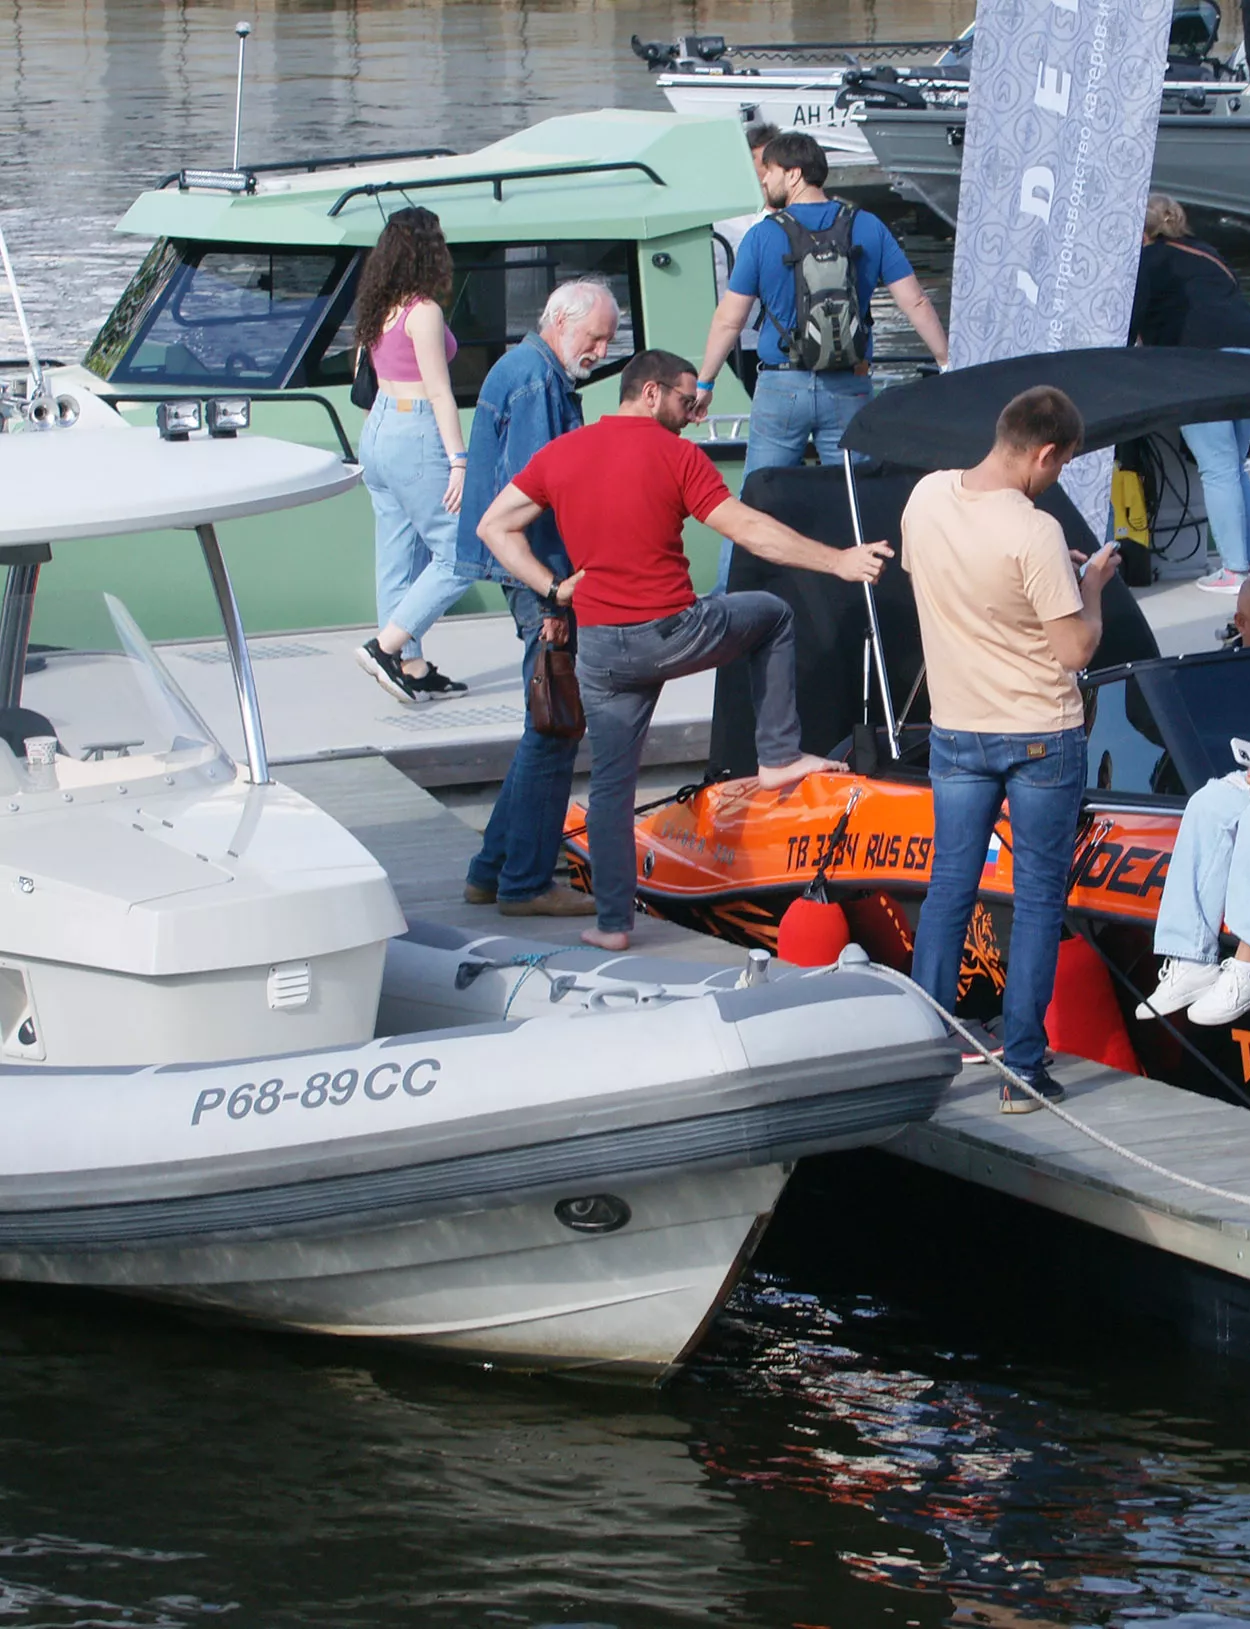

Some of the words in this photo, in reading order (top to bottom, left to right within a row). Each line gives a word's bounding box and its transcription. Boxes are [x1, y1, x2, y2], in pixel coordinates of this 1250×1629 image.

[793, 103, 820, 126] AH
[1056, 126, 1092, 290] производство
[1083, 23, 1109, 120] катеров
[863, 831, 902, 870] RUS
[902, 836, 933, 870] 69
